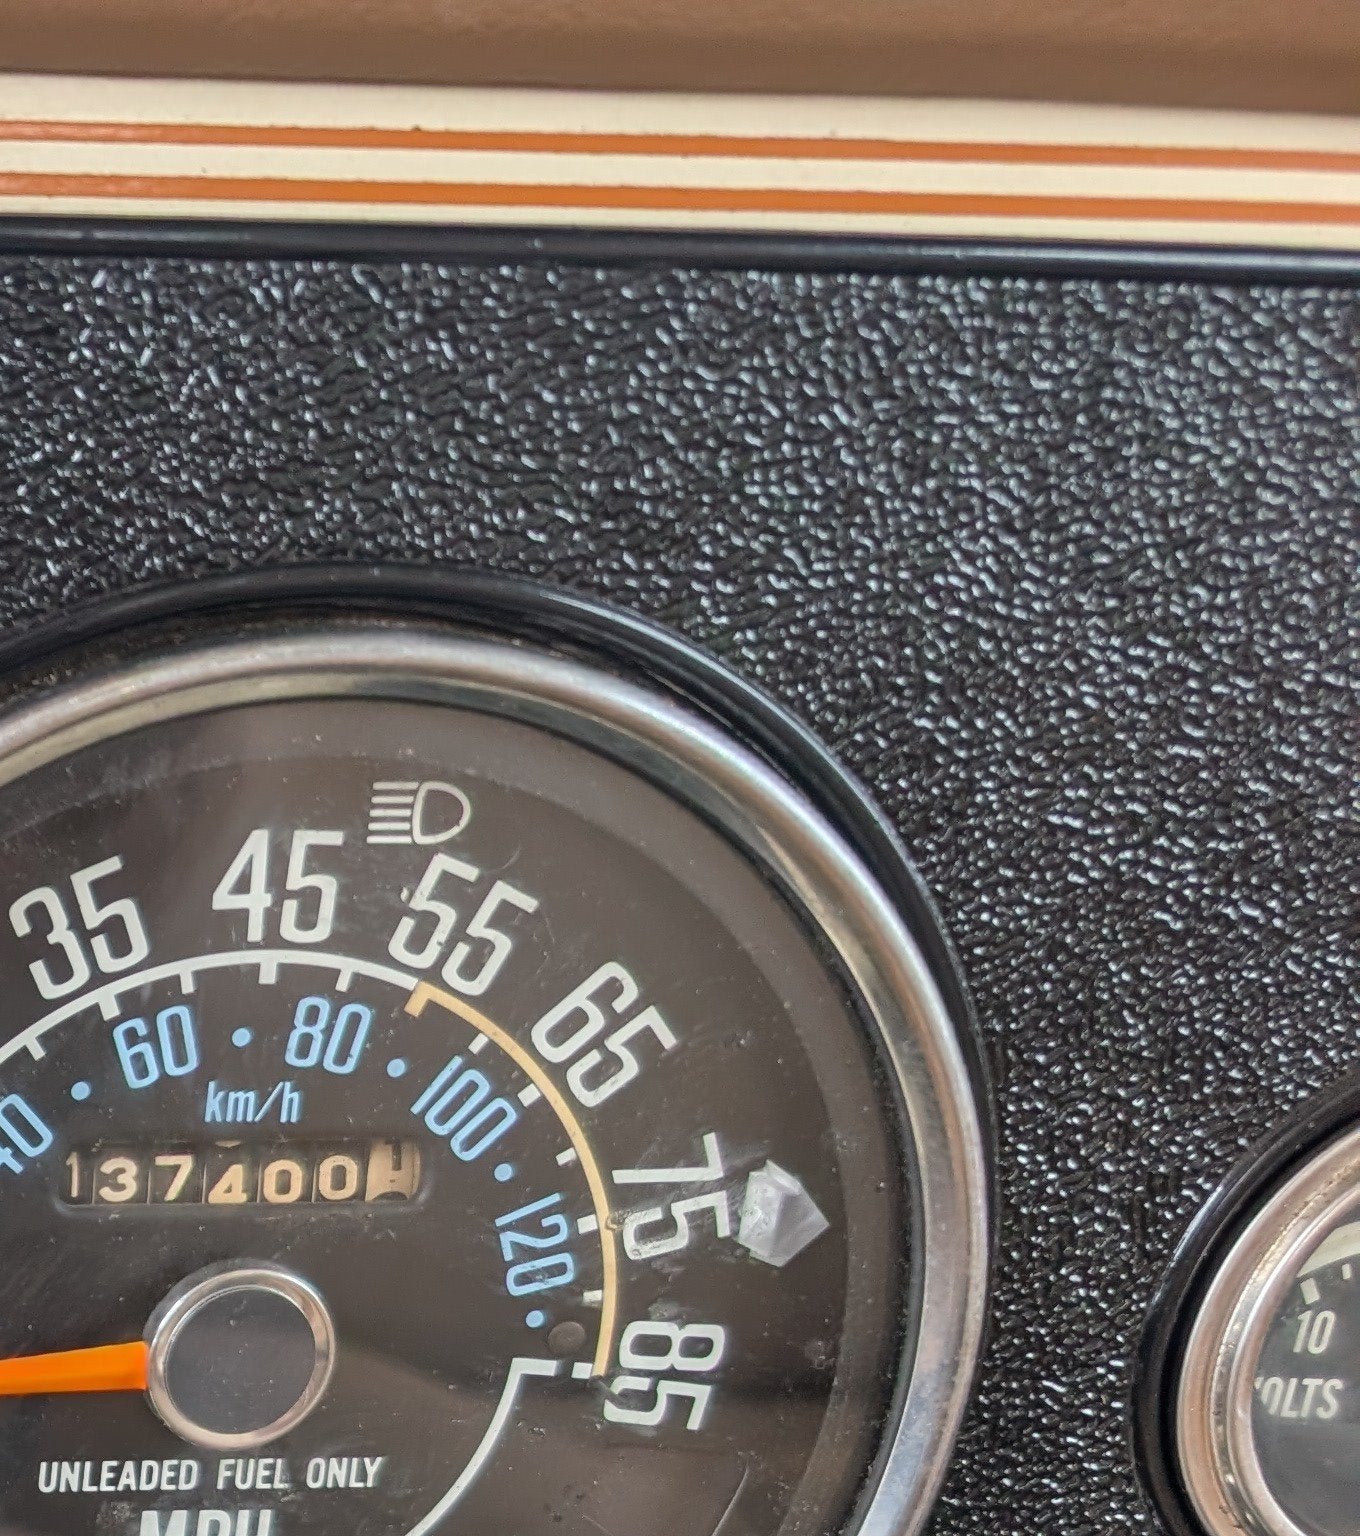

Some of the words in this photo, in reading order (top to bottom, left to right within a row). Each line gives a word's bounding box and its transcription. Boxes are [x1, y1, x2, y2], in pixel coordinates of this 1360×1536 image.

[8, 854, 149, 1001] 35
[211, 828, 345, 944] 45
[387, 852, 539, 996] 55
[113, 1004, 200, 1089] 60
[284, 995, 372, 1075] 80
[530, 960, 679, 1108] 65
[204, 1081, 301, 1125] km/h
[410, 1053, 517, 1163] 100
[494, 1191, 575, 1298] 120
[611, 1130, 731, 1260] 75
[603, 1320, 726, 1431] 85
[1293, 1310, 1336, 1354] 10
[1254, 1376, 1343, 1418] OLTS
[38, 1459, 199, 1493] UNLEADED
[216, 1457, 290, 1490] FUEL
[306, 1456, 383, 1489] ONLY
